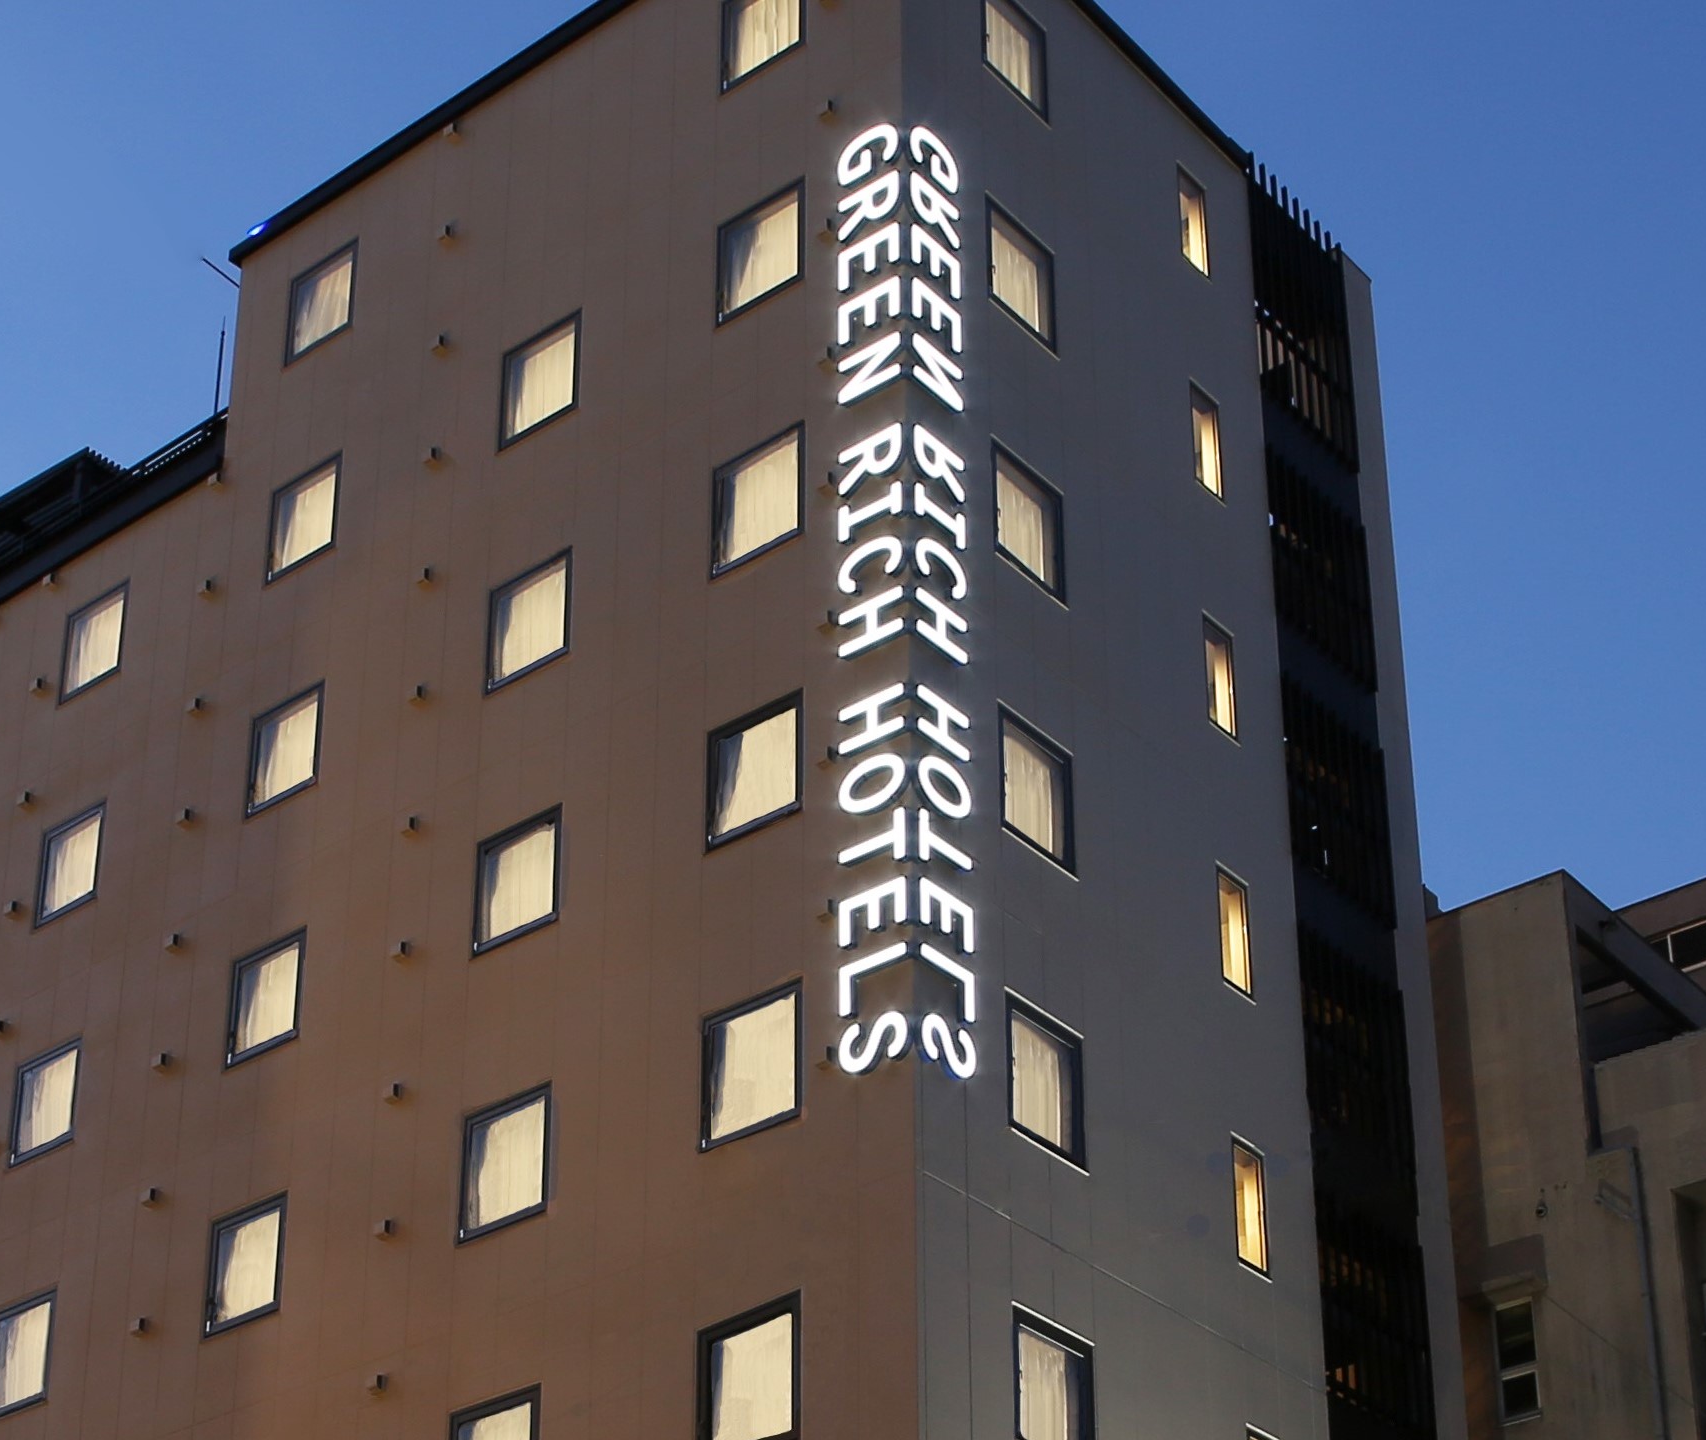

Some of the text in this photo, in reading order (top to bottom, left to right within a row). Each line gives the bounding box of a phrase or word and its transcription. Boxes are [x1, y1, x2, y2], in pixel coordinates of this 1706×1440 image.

[836, 121, 908, 1074] GREEN RICH HOTELS
